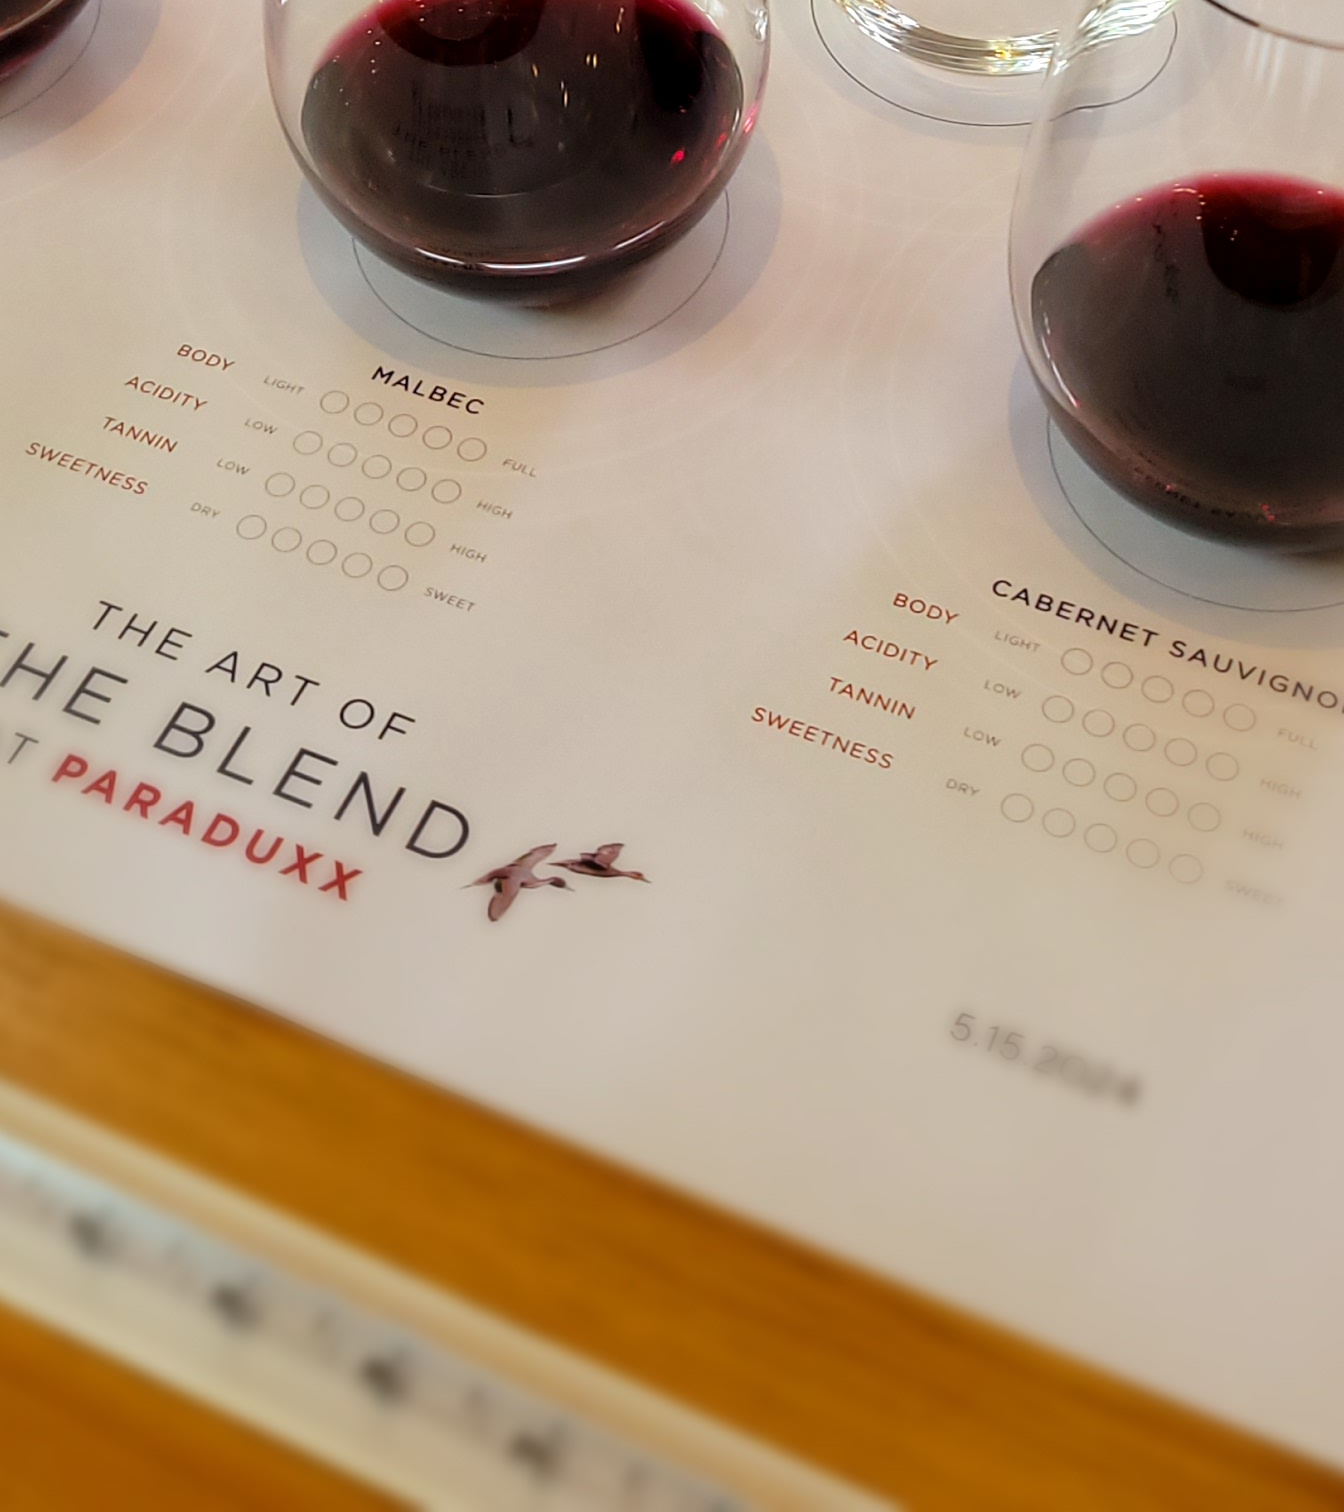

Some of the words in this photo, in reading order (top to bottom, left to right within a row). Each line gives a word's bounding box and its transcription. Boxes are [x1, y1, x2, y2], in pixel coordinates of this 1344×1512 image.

[124, 375, 208, 413] ACIDITY
[244, 418, 278, 436] LOW
[476, 499, 514, 521] HIGH
[176, 343, 236, 372] BODY
[263, 375, 306, 397] LIGHT
[502, 458, 538, 479] FULL
[371, 365, 486, 416] MALBEC
[25, 441, 149, 496] SWEETNESS
[190, 501, 221, 519] DRY
[424, 586, 476, 613] SWEET
[101, 416, 179, 454] TANNIN
[216, 458, 251, 476] LOW
[449, 543, 488, 564] HIGH
[90, 600, 194, 662] THE
[204, 650, 322, 708] ART
[338, 698, 417, 743] OF
[892, 592, 960, 625] BODY
[993, 629, 1043, 654] LIGHT
[1276, 726, 1319, 751] FULL
[991, 578, 1160, 648] CABERNET
[151, 700, 472, 861] BLEND
[750, 706, 895, 771] SWEETNESS
[945, 777, 981, 798] DRY
[828, 676, 917, 721] TANNIN
[962, 725, 1003, 748] LOW
[1242, 827, 1286, 852] HIGH
[842, 628, 939, 672] ACIDITY
[982, 678, 1023, 701] LOW
[1259, 777, 1303, 801] HIGH
[50, 752, 365, 903] PARADUXX
[950, 1012, 1140, 1107] 5.15.20
